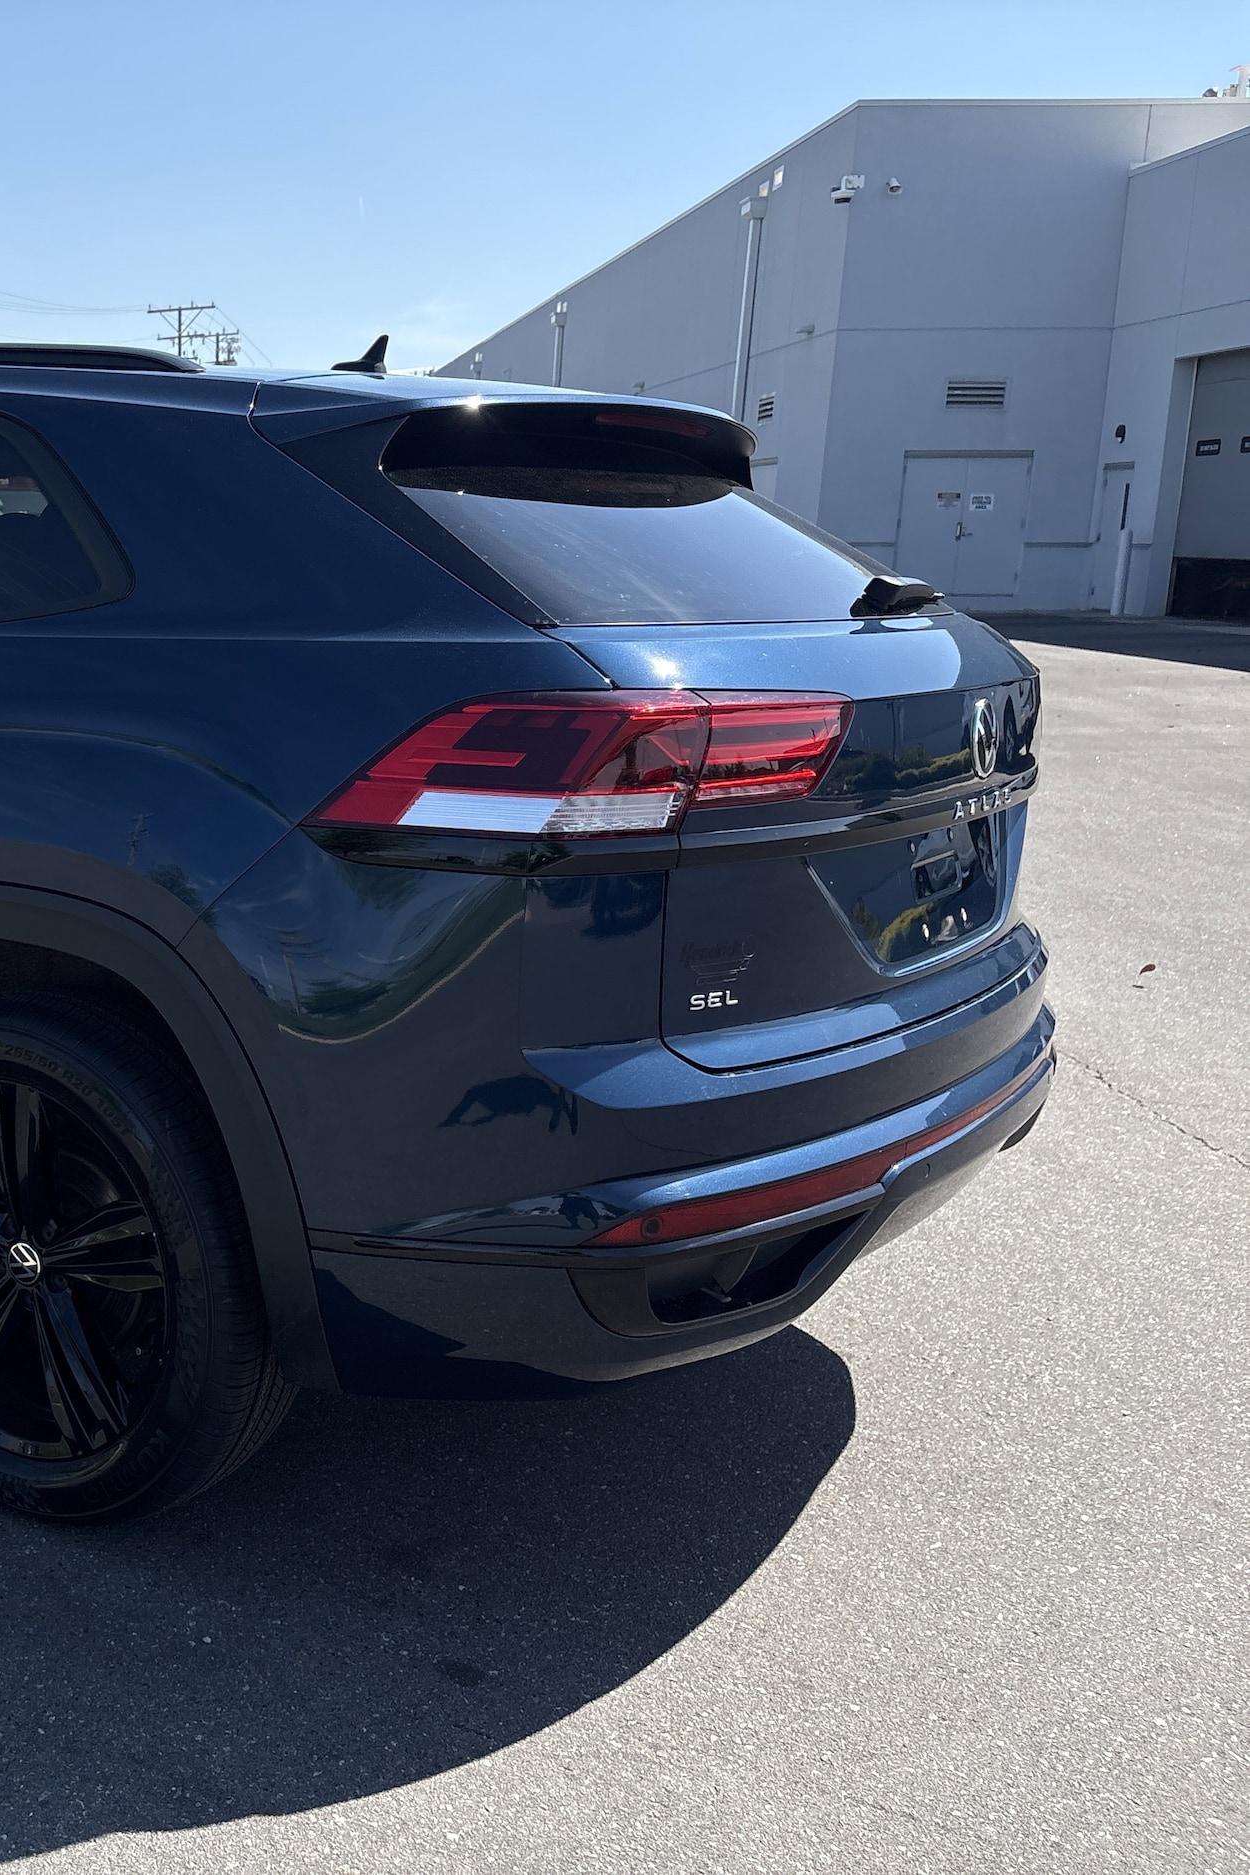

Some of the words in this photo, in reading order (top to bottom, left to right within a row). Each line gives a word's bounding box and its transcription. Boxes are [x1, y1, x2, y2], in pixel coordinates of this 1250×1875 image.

[952, 788, 1012, 820] ATLAS
[689, 990, 739, 1011] SEL
[4, 1044, 59, 1074] 255/50
